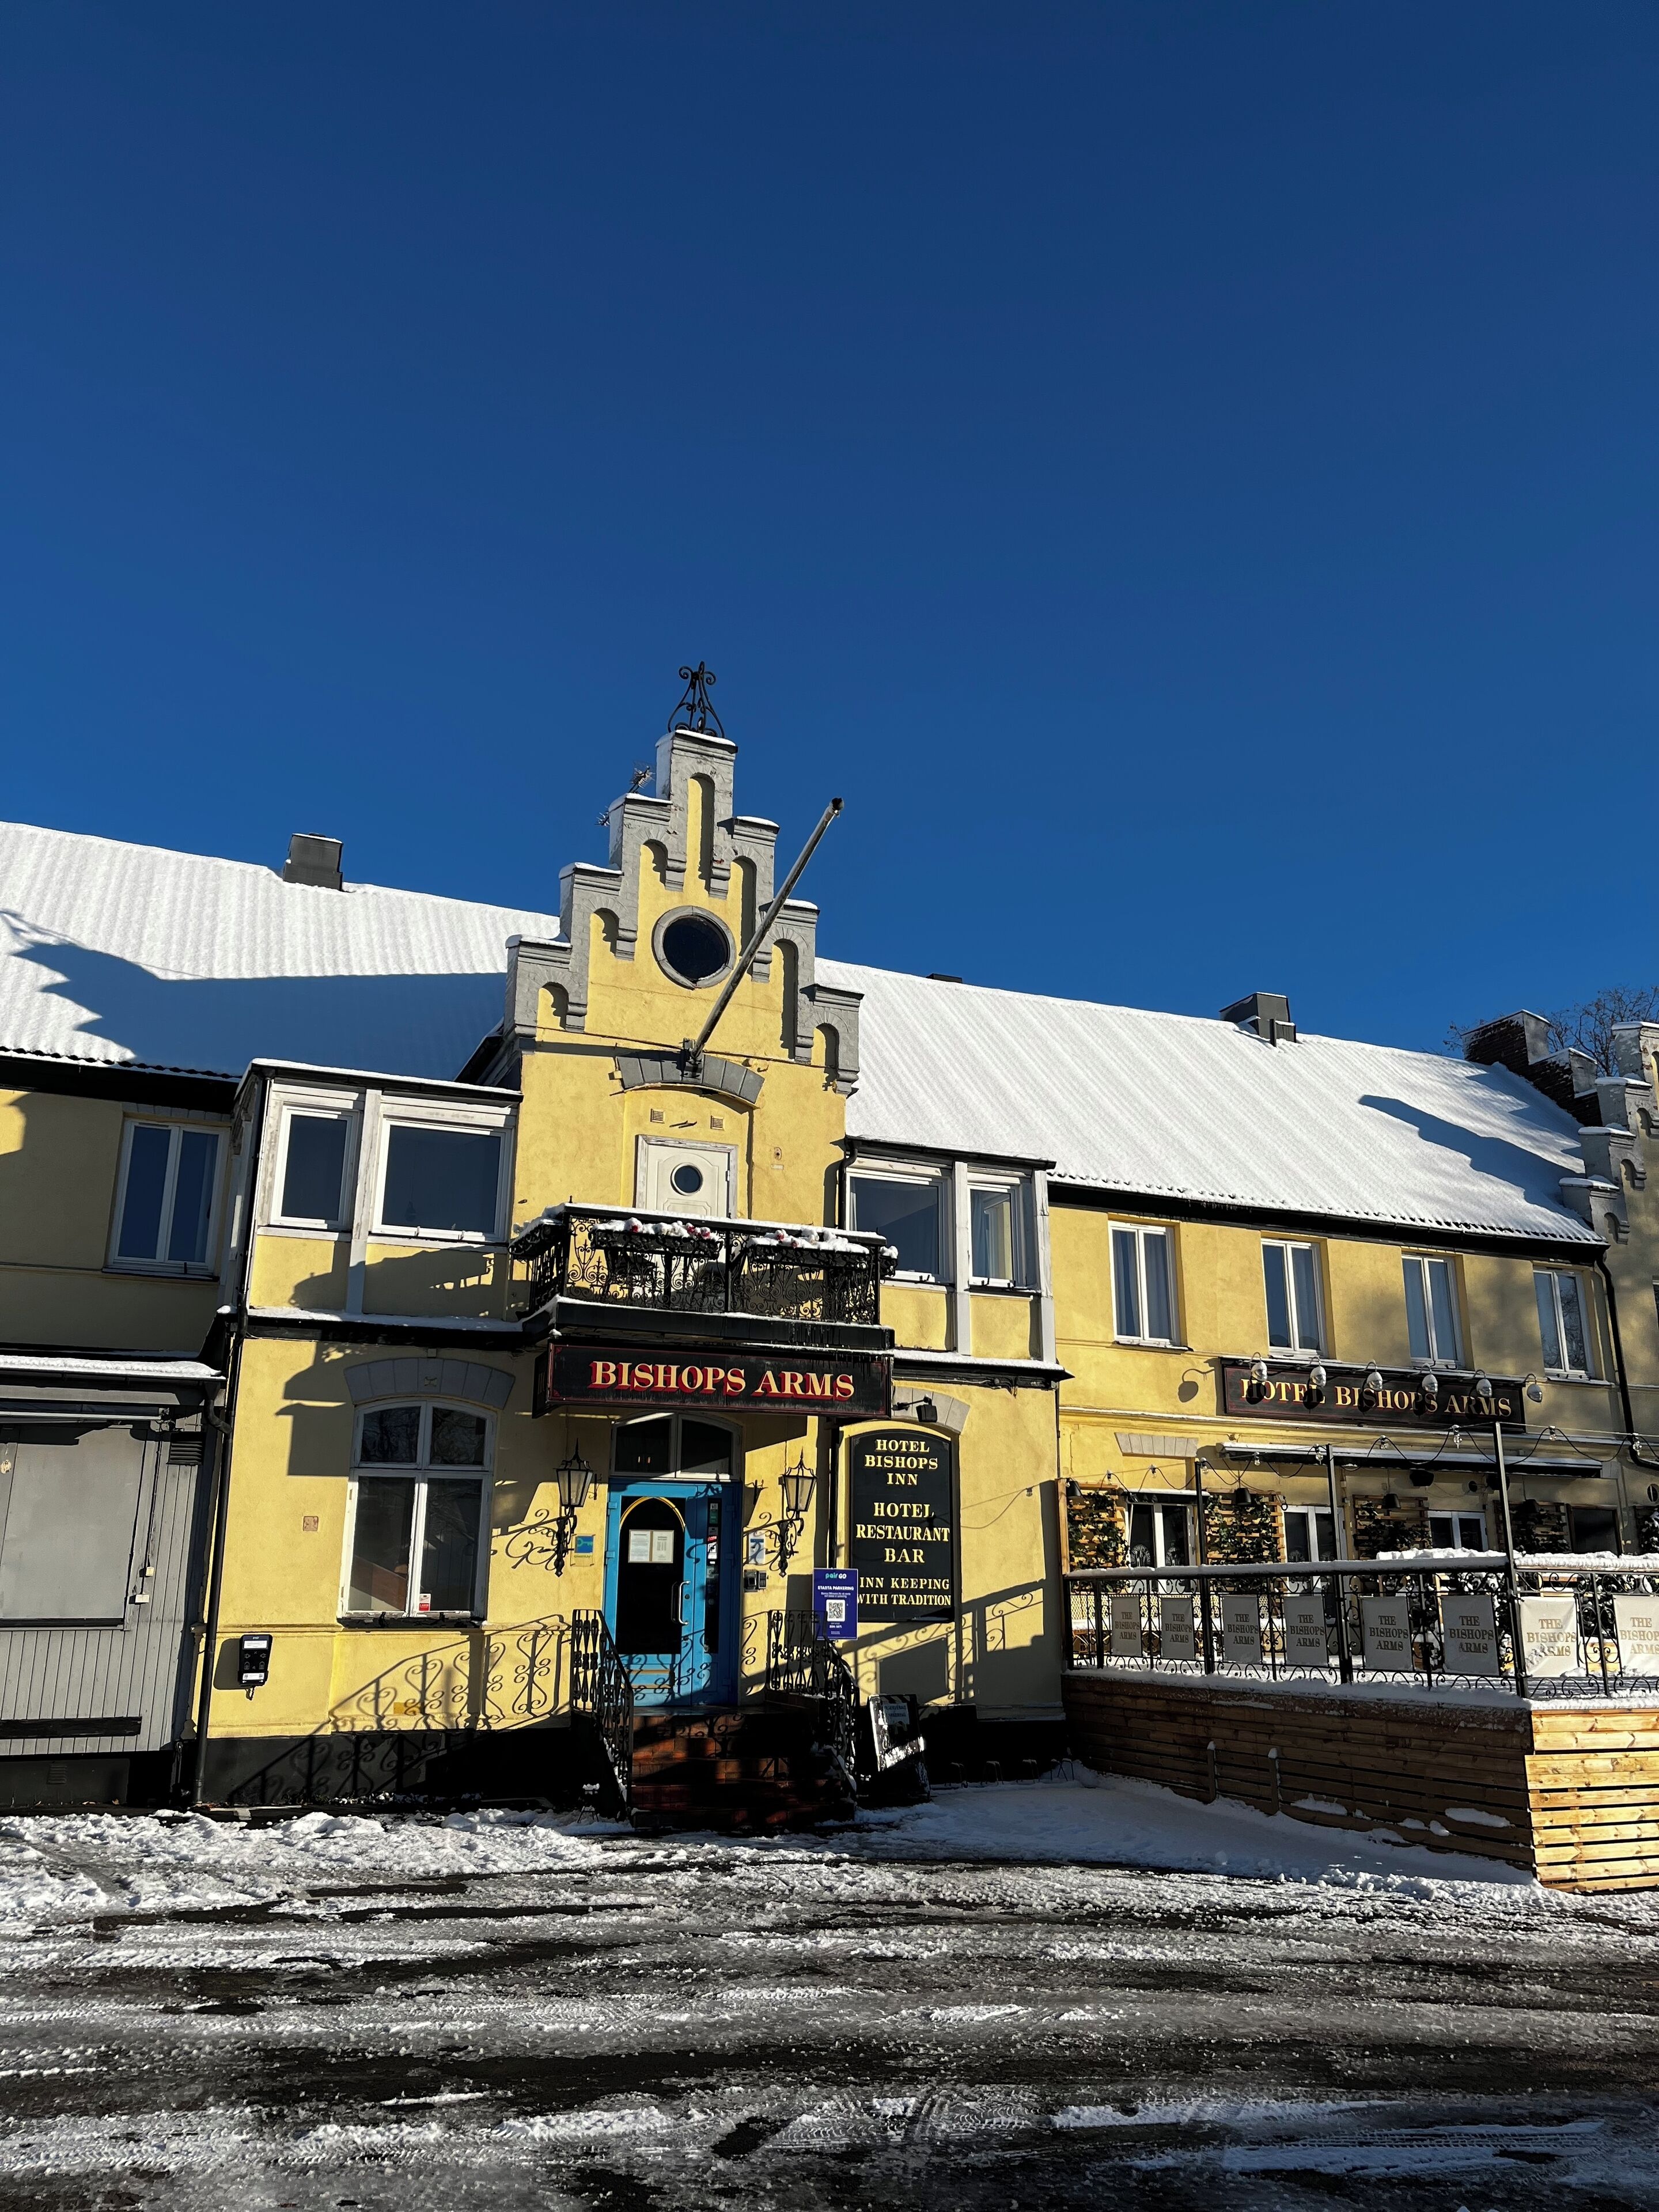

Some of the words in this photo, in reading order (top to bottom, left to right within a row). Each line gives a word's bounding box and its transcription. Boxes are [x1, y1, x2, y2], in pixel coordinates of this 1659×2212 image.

[590, 1361, 746, 1393] BISHOPS
[753, 1370, 855, 1398] ARMS
[1241, 1378, 1325, 1404] HOTEL
[1335, 1386, 1438, 1412] BISHOPS
[1444, 1395, 1512, 1417] ARMS
[876, 1439, 930, 1453] HOTEL
[865, 1455, 938, 1469] BISHOPS
[887, 1473, 918, 1486] INN
[873, 1502, 935, 1518] HOTEL
[855, 1524, 950, 1542] RESTAURANT
[884, 1548, 925, 1563] BAR
[859, 1577, 884, 1588] INN
[891, 1578, 950, 1590] KEEPING
[857, 1593, 888, 1605] WITH
[891, 1594, 951, 1606] TRADITION
[1121, 1612, 1132, 1620] THE
[1172, 1613, 1185, 1622] THE
[1234, 1613, 1249, 1622] THE
[1297, 1614, 1314, 1624] THE
[1378, 1615, 1397, 1626] THE
[1459, 1615, 1480, 1626] THE
[1115, 1621, 1140, 1630] BISHOPS
[1165, 1623, 1192, 1633] BISHOPS
[1539, 1618, 1563, 1629] THE
[1630, 1617, 1652, 1628] THE
[1227, 1624, 1259, 1634] BISHOPS
[1290, 1625, 1325, 1636] BISHOPS
[1369, 1627, 1409, 1639] BISHOPS
[1449, 1628, 1494, 1641] BISHOPS
[1119, 1631, 1137, 1640] ARMS
[1170, 1634, 1189, 1643] ARMS
[1233, 1635, 1255, 1645] ARMS
[1527, 1632, 1577, 1643] BISHOPS
[1296, 1637, 1321, 1647] ARMS
[1376, 1640, 1404, 1652] ARMS
[1459, 1642, 1488, 1654] ARMS
